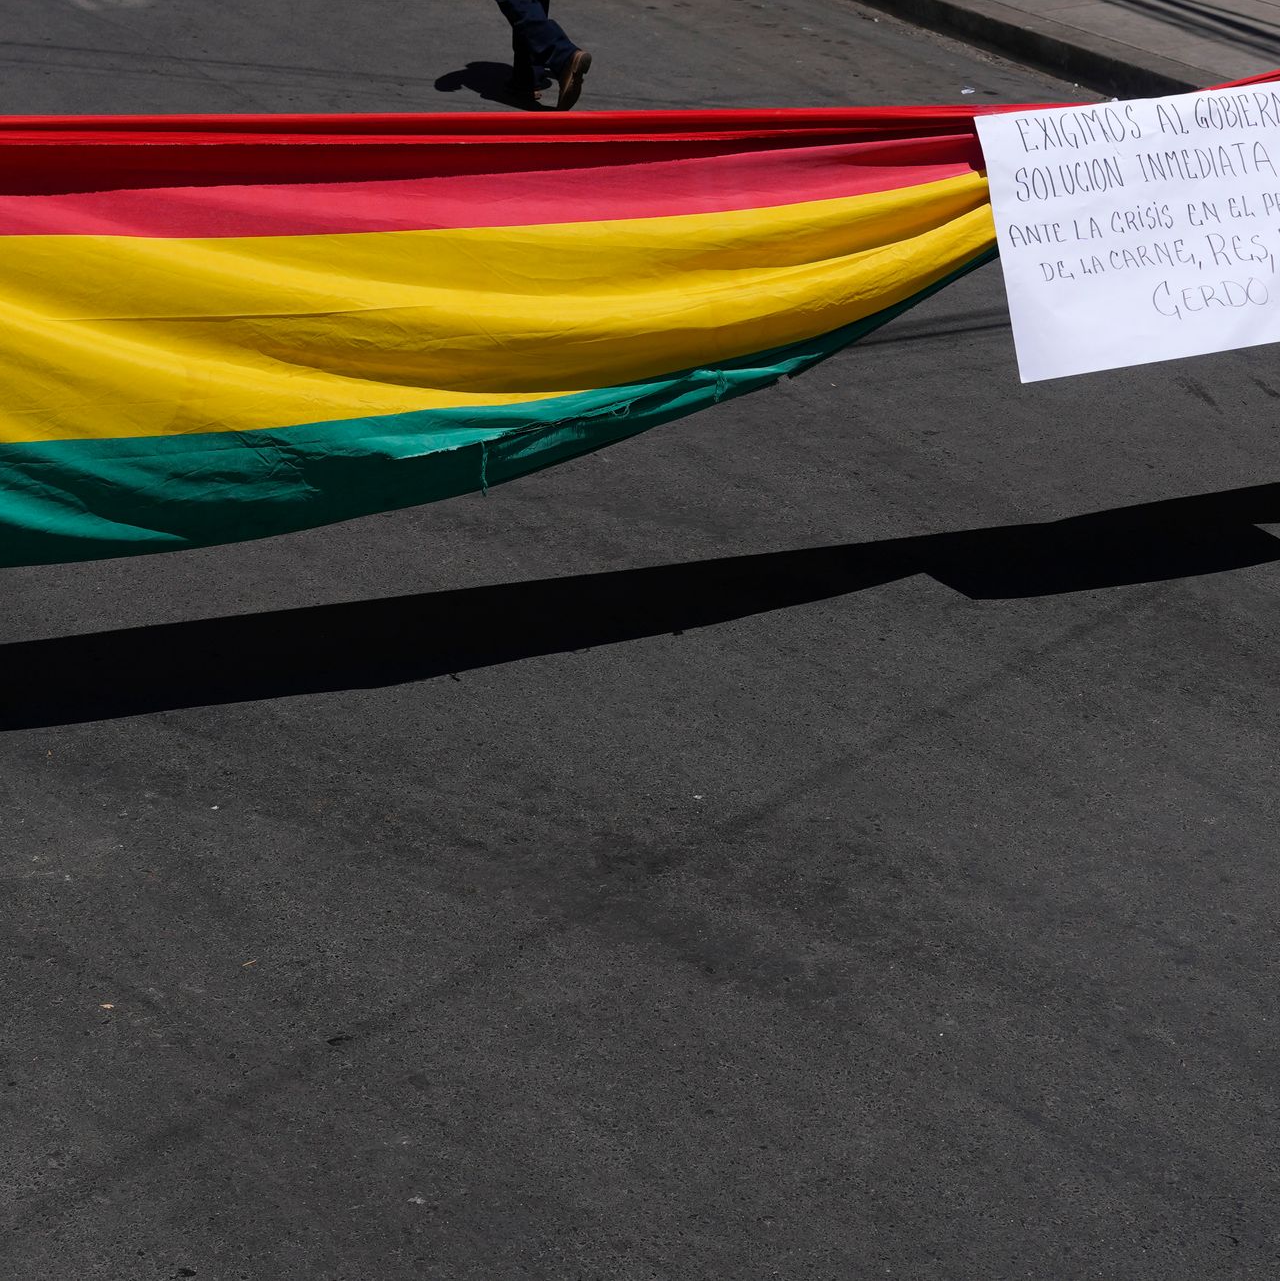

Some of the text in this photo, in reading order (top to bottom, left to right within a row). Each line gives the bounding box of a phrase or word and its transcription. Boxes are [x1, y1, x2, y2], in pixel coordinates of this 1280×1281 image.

[1016, 105, 1143, 153] EXIGIMOS
[1156, 103, 1191, 135] AL
[1015, 140, 1279, 203] SOLUCION INMEDIATA
[1008, 222, 1067, 248] ANTE
[1075, 216, 1103, 241] LA
[1190, 202, 1221, 227] EN
[1231, 194, 1257, 221] EL
[1040, 261, 1075, 283] DE
[1082, 252, 1105, 275] LA
